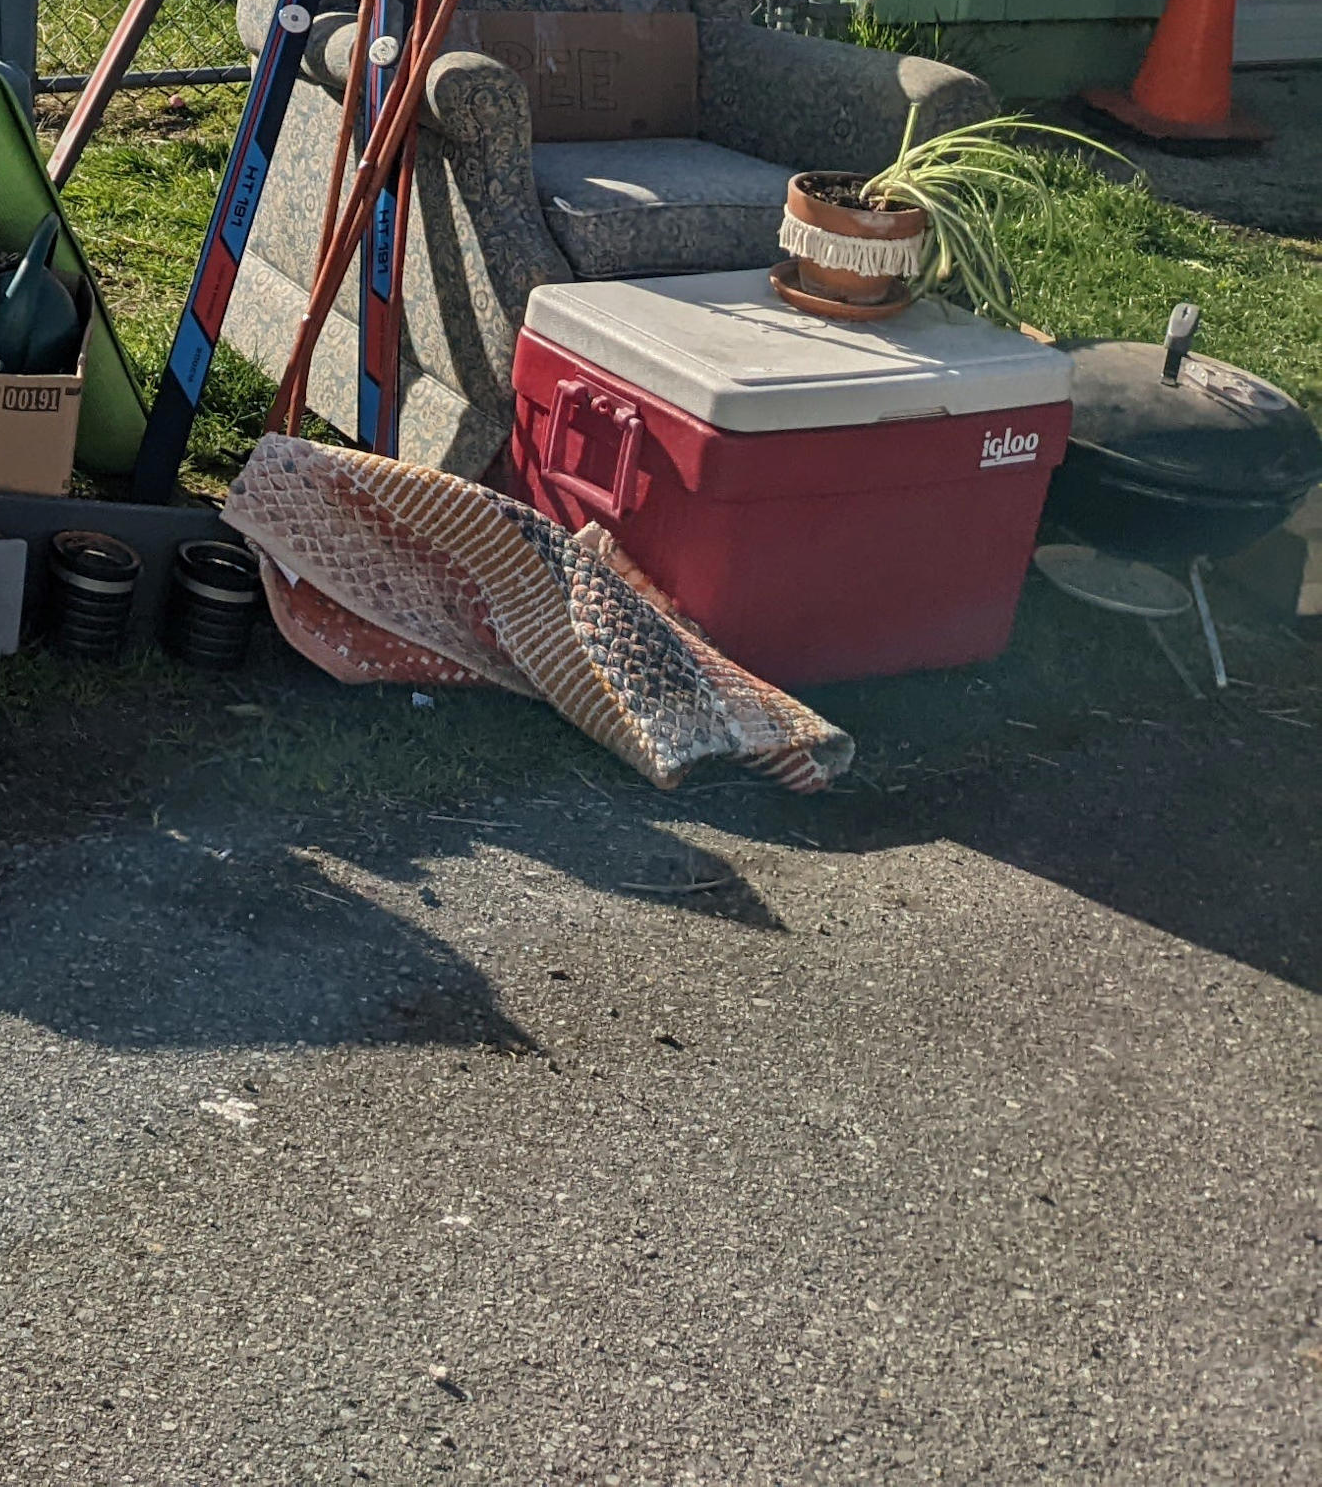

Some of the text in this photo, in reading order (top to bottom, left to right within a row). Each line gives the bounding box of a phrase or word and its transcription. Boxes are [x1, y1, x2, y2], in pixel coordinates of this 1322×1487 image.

[229, 165, 259, 228] HT 191
[378, 209, 391, 274] HT 191
[4, 387, 59, 411] 00191
[981, 427, 1039, 462] igloo
